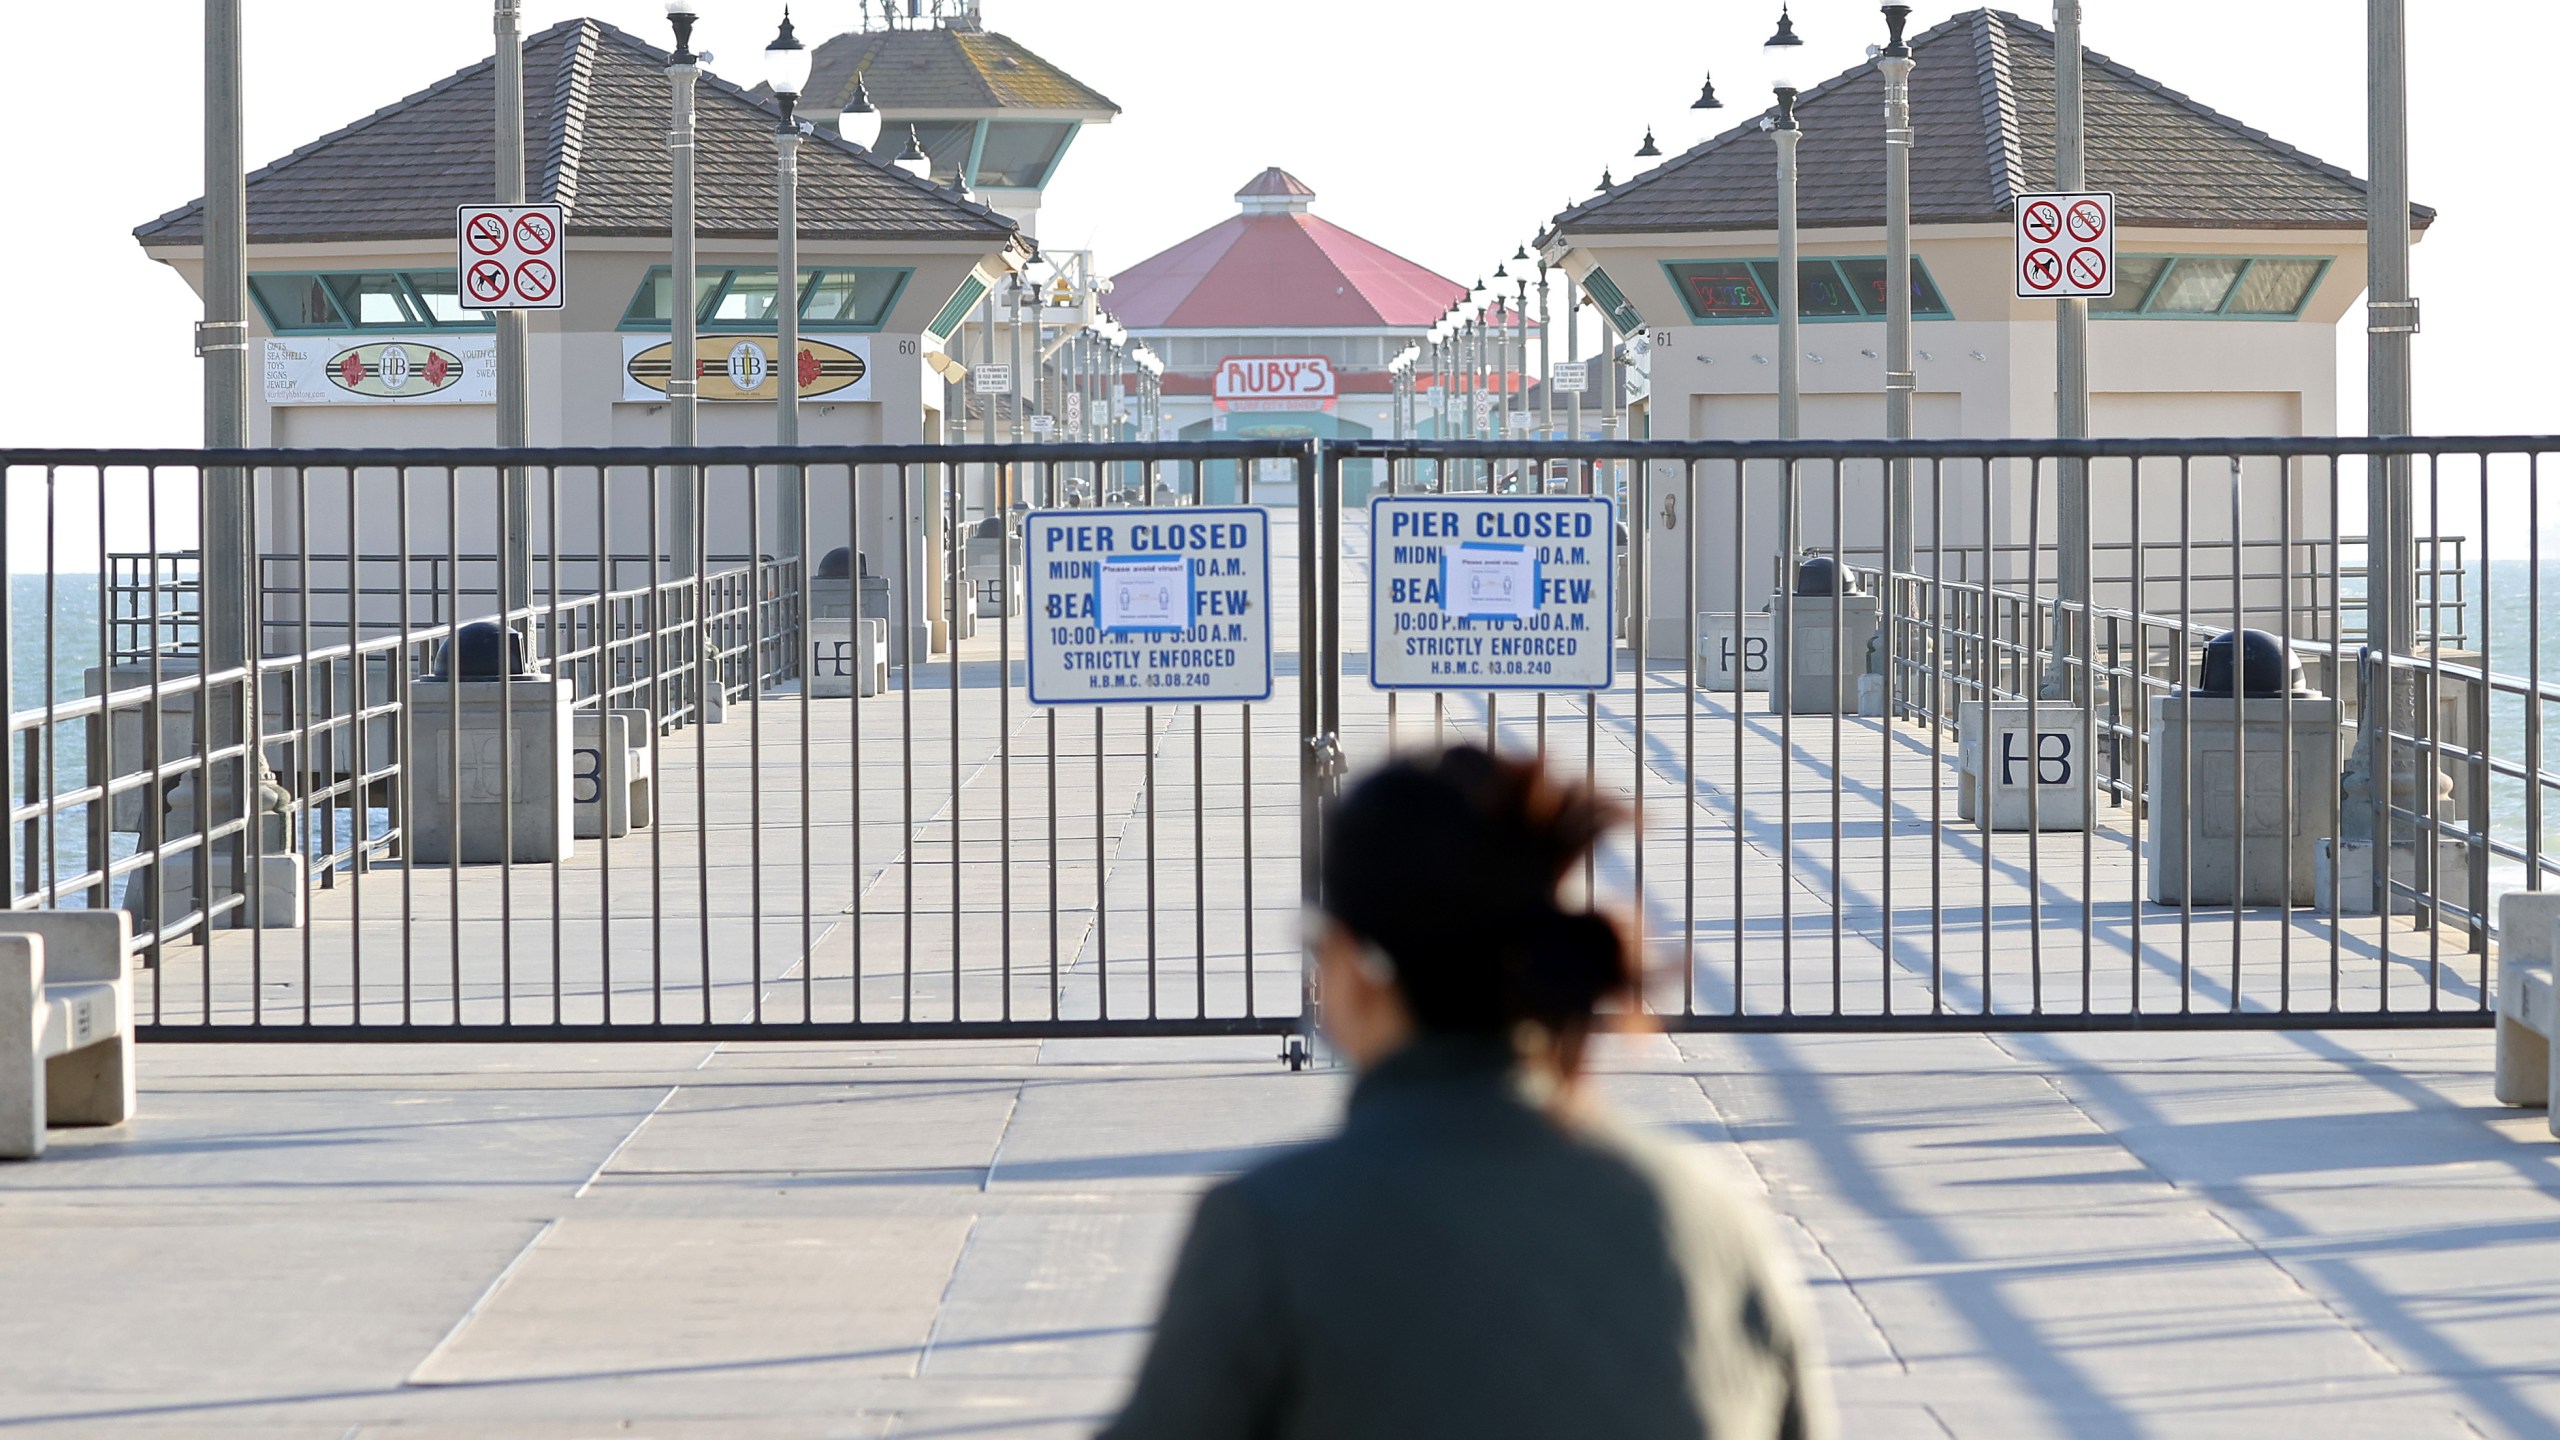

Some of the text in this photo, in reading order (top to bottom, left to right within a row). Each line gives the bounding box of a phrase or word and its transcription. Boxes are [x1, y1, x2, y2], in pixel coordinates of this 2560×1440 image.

[899, 340, 916, 355] 60
[1657, 332, 1673, 347] 61
[267, 351, 308, 360] SEA SHELLS
[462, 350, 486, 360] YOUTH
[267, 361, 285, 370] TOYS
[267, 371, 288, 380] SIGNS
[476, 369, 497, 378] SWEA
[732, 357, 761, 376] HB
[267, 380, 298, 389] JEWELRY
[1228, 362, 1326, 393] RUBY'S
[480, 390, 497, 398] 714-
[1392, 511, 1593, 538] PIER CLOSED
[1046, 523, 1247, 552] PIER CLOSED
[1554, 545, 1591, 565] A.M.
[1049, 560, 1093, 580] MIDN
[1209, 557, 1247, 577] A.M.
[1392, 577, 1592, 605] BEA FEW
[1047, 590, 1248, 619] BEA FEW
[1393, 612, 1439, 632] 10:00
[1554, 612, 1591, 631] A.M.
[1050, 626, 1096, 646] 10:00
[1211, 623, 1248, 643] A.M.
[1405, 637, 1578, 657] STRICTLY ENFORCED
[1721, 636, 1768, 672] HB
[1063, 649, 1236, 671] STRICTLY ENFORCED
[1430, 660, 1484, 675] H.B.M.C.
[1089, 673, 1143, 689] H.B.M.C.
[2003, 732, 2072, 785] HB
[573, 748, 602, 804] B
